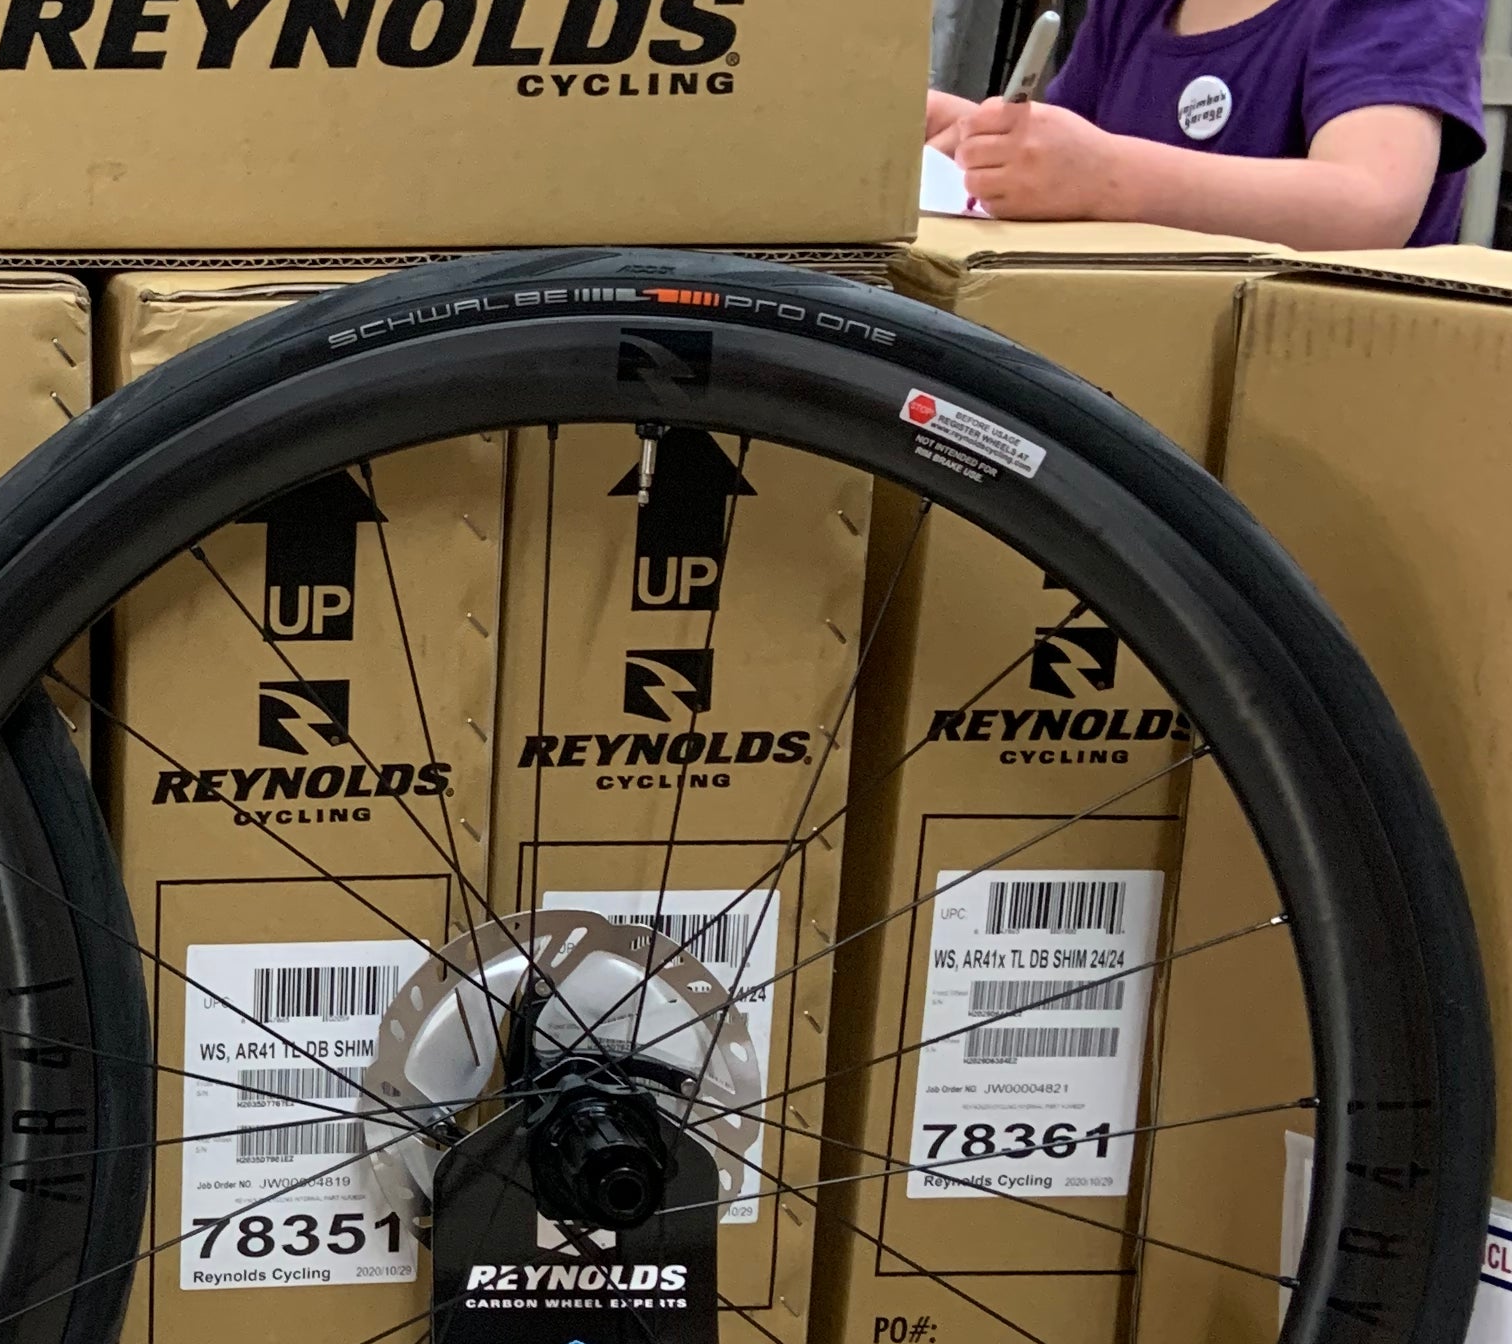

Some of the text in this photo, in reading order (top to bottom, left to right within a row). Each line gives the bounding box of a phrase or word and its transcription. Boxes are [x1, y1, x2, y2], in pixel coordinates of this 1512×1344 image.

[517, 72, 736, 98] CYCLING
[326, 288, 570, 350] SCHWALBE
[938, 414, 982, 441] REGISTER
[982, 433, 1017, 456] WHEELS
[955, 411, 1022, 447] BEFORE USAGE
[915, 434, 999, 478] NOT INTENDED FOR
[932, 453, 963, 474] BRAKE
[637, 556, 719, 605] UP
[269, 584, 352, 636] UP
[517, 730, 811, 769] REYNOLDS
[999, 749, 1129, 765] CYCLING
[152, 762, 452, 805] REYNOLDS
[595, 773, 731, 791] CYCLING
[233, 806, 371, 826] CYCLING
[941, 907, 966, 920] UPC
[934, 949, 1125, 971] WS, AR41x TL DB SHIM 24/24
[200, 1042, 231, 1063] WS,
[235, 1042, 276, 1061] AR41
[306, 1040, 329, 1057] DB
[334, 1039, 374, 1057] SHIM
[984, 1083, 1069, 1094] JW00004821
[922, 1122, 1111, 1159] 78361
[197, 1180, 213, 1190] Job
[214, 1180, 237, 1190] Order
[923, 1175, 992, 1190] Reynolds
[997, 1174, 1053, 1189] Cycling
[192, 1211, 401, 1259] 78351
[193, 1268, 266, 1286] Reynolds
[272, 1266, 331, 1282] Cycling
[465, 1264, 688, 1292] REYNOLDS
[465, 1298, 538, 1309] CARBON
[545, 1298, 603, 1309] WHEEL
